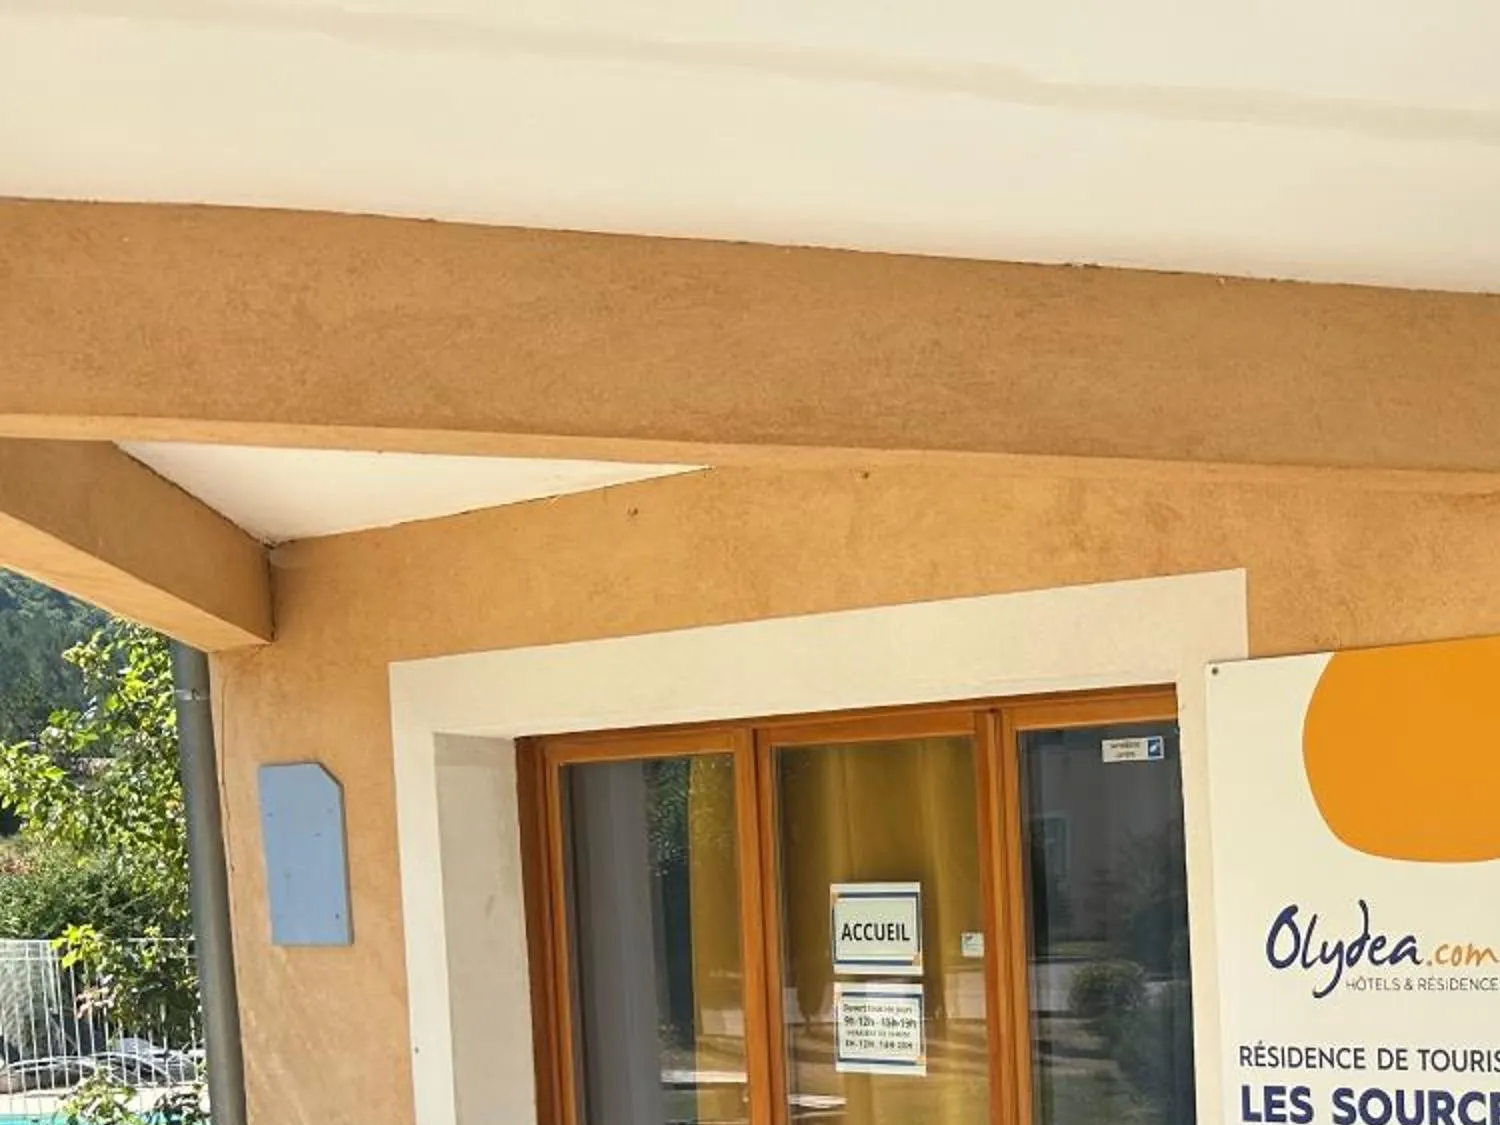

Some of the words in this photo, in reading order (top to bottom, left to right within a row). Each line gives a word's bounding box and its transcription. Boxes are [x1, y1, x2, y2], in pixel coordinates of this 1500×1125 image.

[841, 922, 911, 942] ACCUEIL
[1345, 975, 1401, 992] HÔTELS
[1403, 977, 1414, 991] &
[1239, 1040, 1366, 1070] RÉSIDENCE
[1377, 1048, 1409, 1071] DE
[1241, 1084, 1314, 1124] LES
